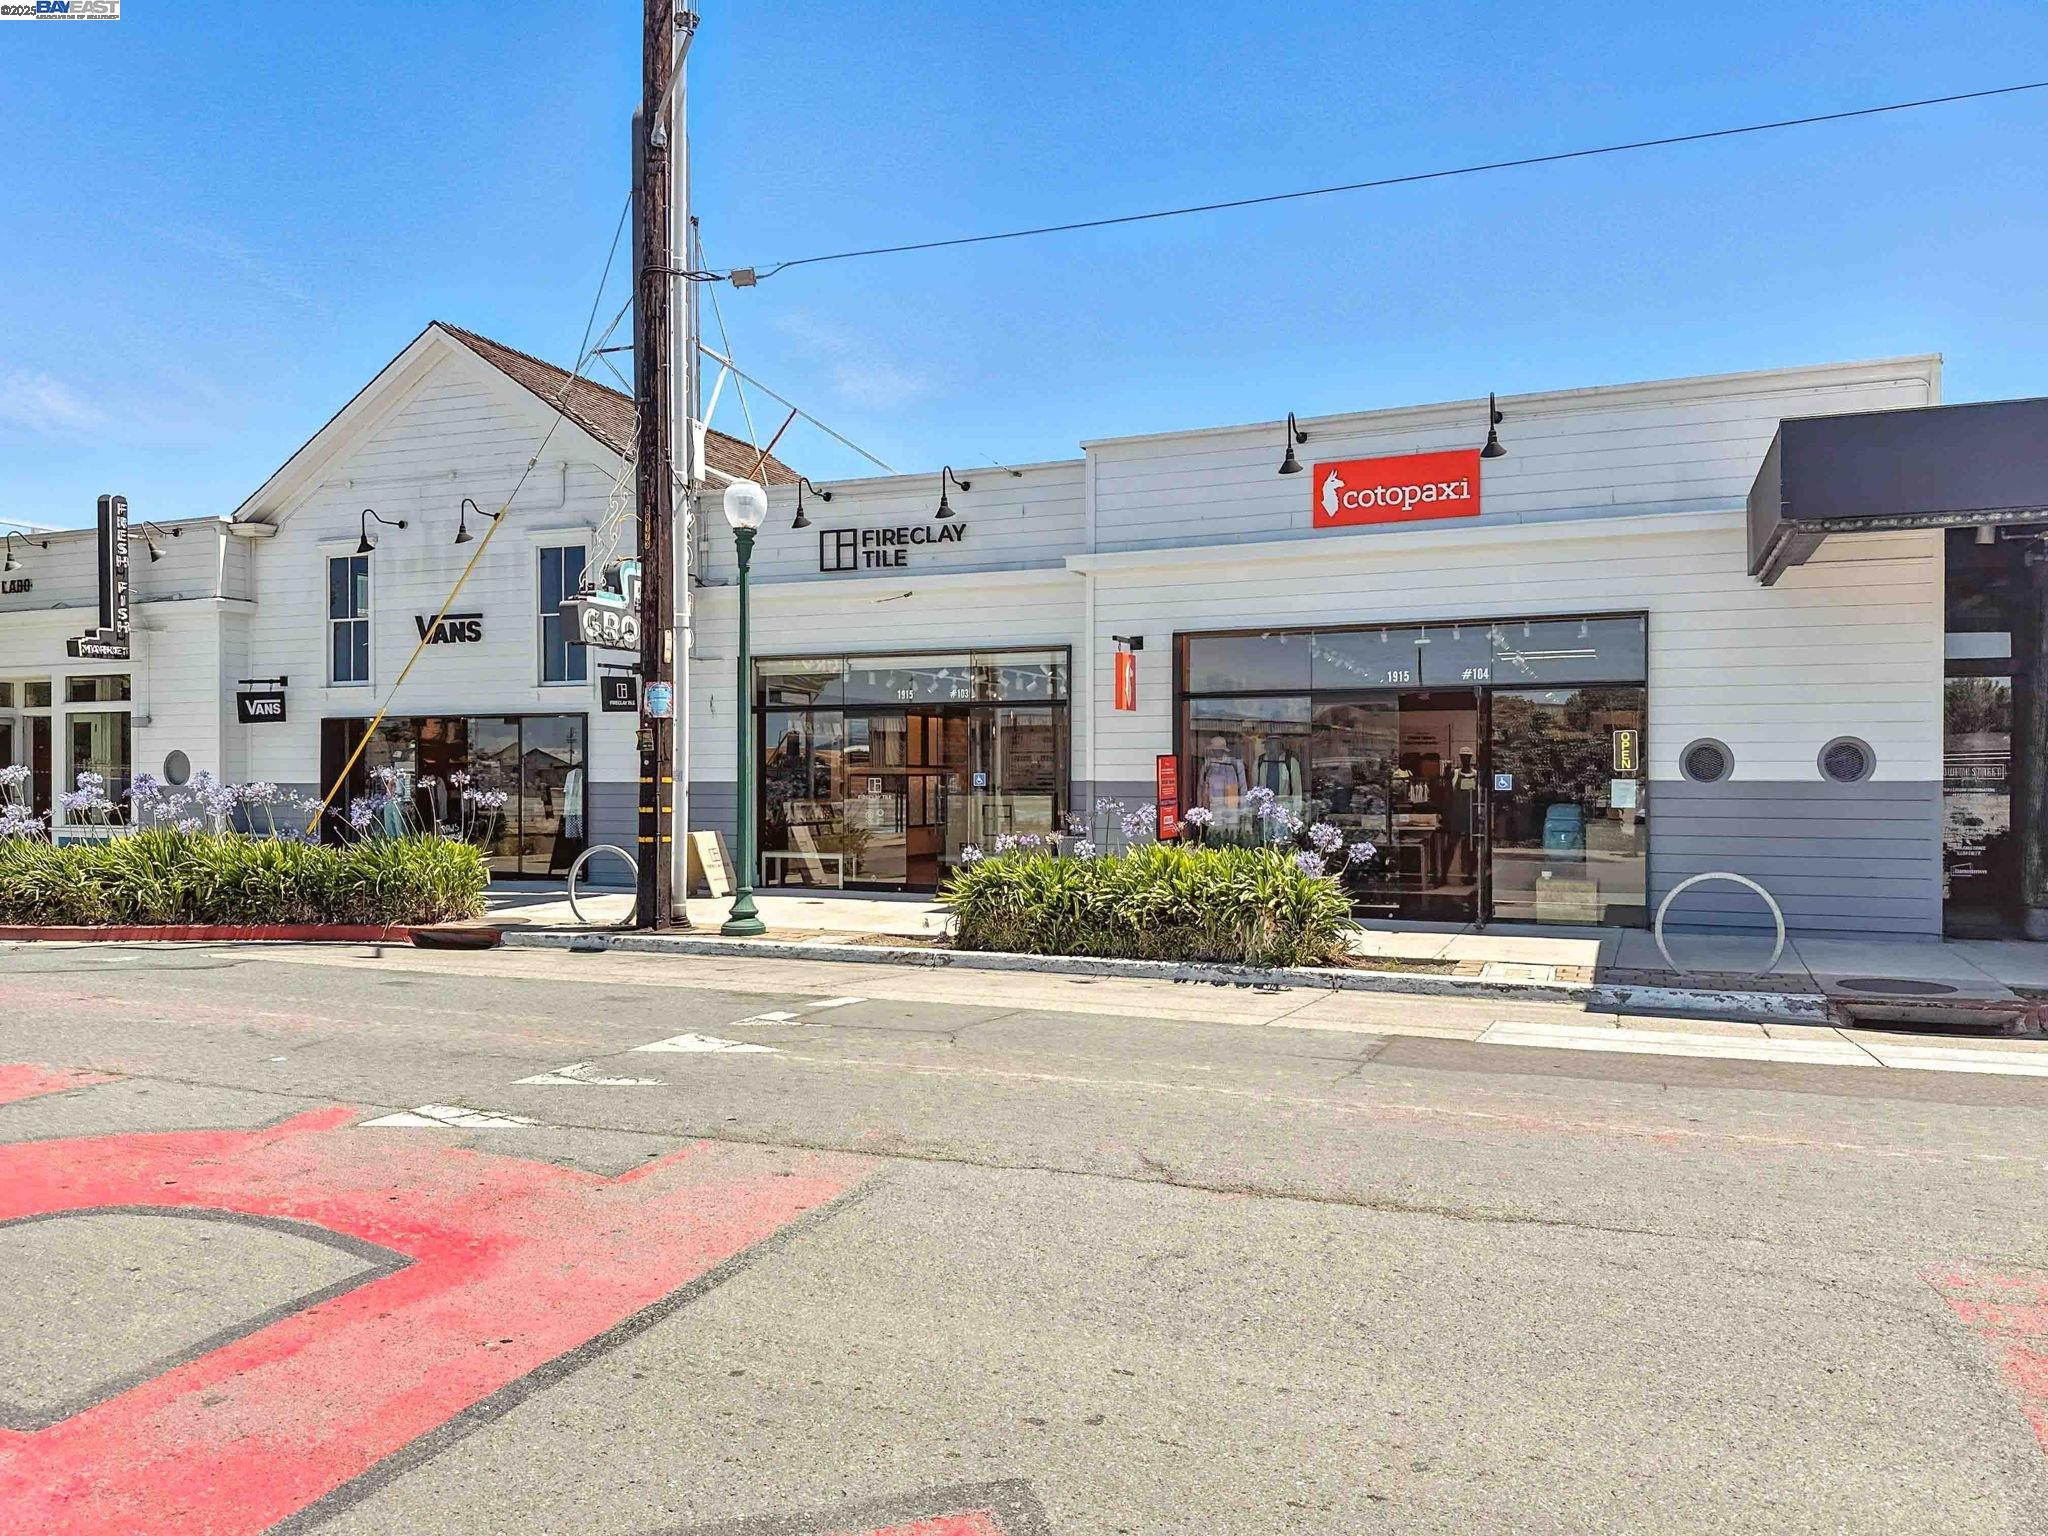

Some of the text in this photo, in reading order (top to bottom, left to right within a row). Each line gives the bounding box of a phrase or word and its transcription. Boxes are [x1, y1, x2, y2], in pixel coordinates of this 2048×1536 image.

[1343, 477, 1471, 511] cotopaxi
[116, 502, 129, 568] FRESH
[862, 524, 966, 547] FIRECLAY
[862, 549, 907, 568] TILE
[117, 581, 130, 633] FISH
[415, 613, 483, 644] VANS
[81, 644, 129, 656] MARKET
[1387, 667, 1489, 682] 1915 #104
[897, 688, 969, 699] 1915 #103
[245, 699, 281, 715] VANS
[1621, 732, 1631, 769] OPEN
